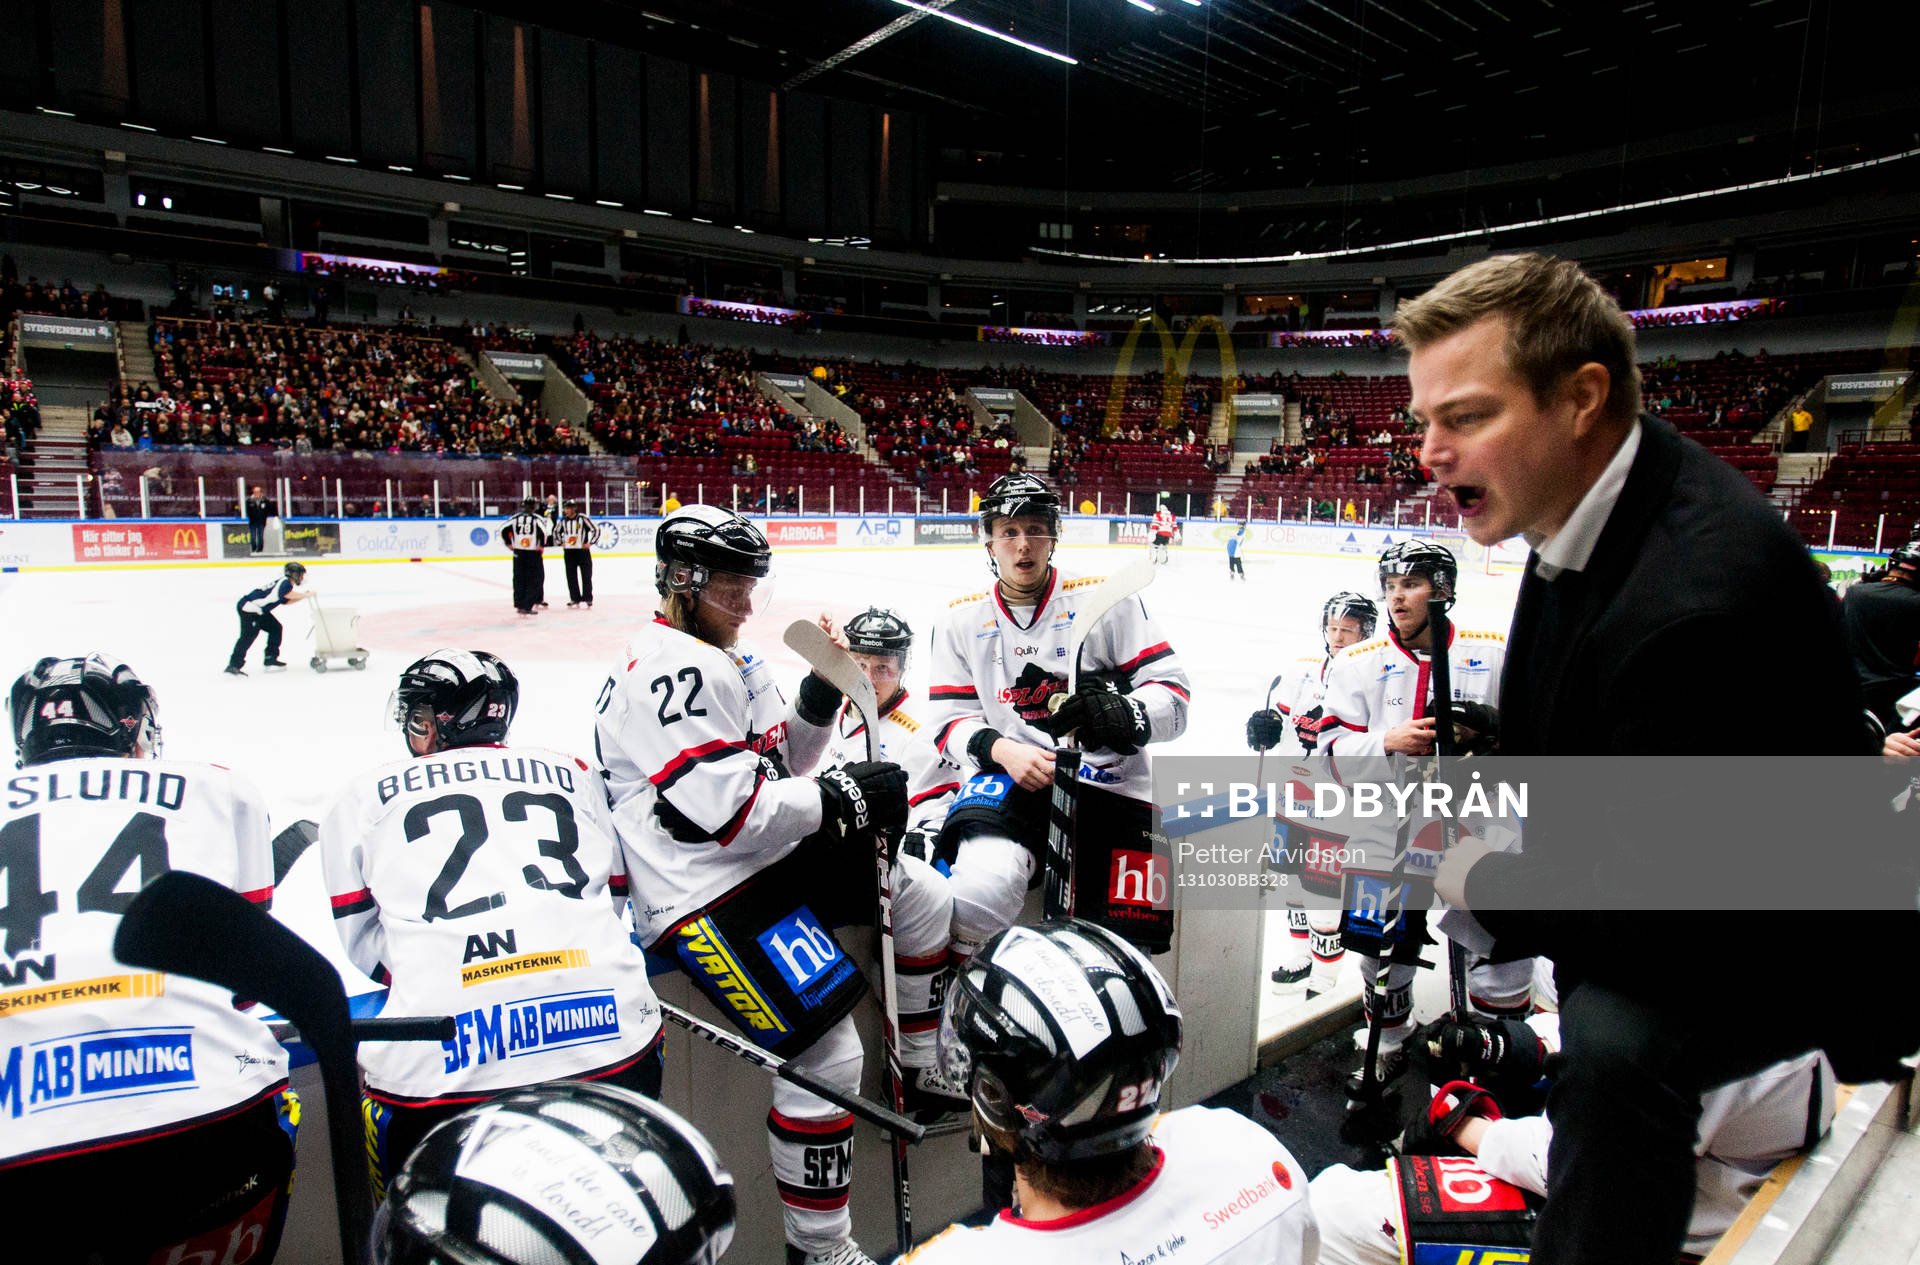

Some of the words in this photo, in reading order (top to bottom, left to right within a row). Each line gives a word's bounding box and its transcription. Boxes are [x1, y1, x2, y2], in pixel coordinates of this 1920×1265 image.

[23, 323, 96, 337] SYDSVENSKAN
[1831, 379, 1894, 390] SYDSVENSKAN
[82, 530, 99, 543] Här
[102, 530, 126, 543] sitter
[128, 530, 142, 544] jag
[357, 535, 426, 552] ColdZyme
[621, 524, 653, 536] Skåne
[779, 526, 825, 541] ARBOGA
[920, 524, 973, 535] OPTIMERA
[84, 545, 101, 558] och
[860, 639, 884, 648] Reebok
[40, 700, 75, 719] 44
[487, 703, 506, 718] 23
[650, 666, 708, 727] 22
[7, 769, 187, 811] SLUND
[377, 757, 576, 805] BERGLUND
[404, 790, 590, 924] 23
[0, 811, 172, 958] 44
[1112, 854, 1167, 904] hb
[463, 928, 518, 964] AN
[769, 916, 836, 987] hb
[462, 954, 563, 982] MASKINTEKNIK
[509, 1002, 540, 1050] AB
[545, 1003, 616, 1035] MINING
[973, 1012, 998, 1043] Reebok
[29, 1044, 75, 1105] AB
[86, 1045, 190, 1082] MINING
[804, 1139, 851, 1188] SFM
[902, 1180, 911, 1223] CCM
[1203, 1175, 1278, 1231] Swedbank
